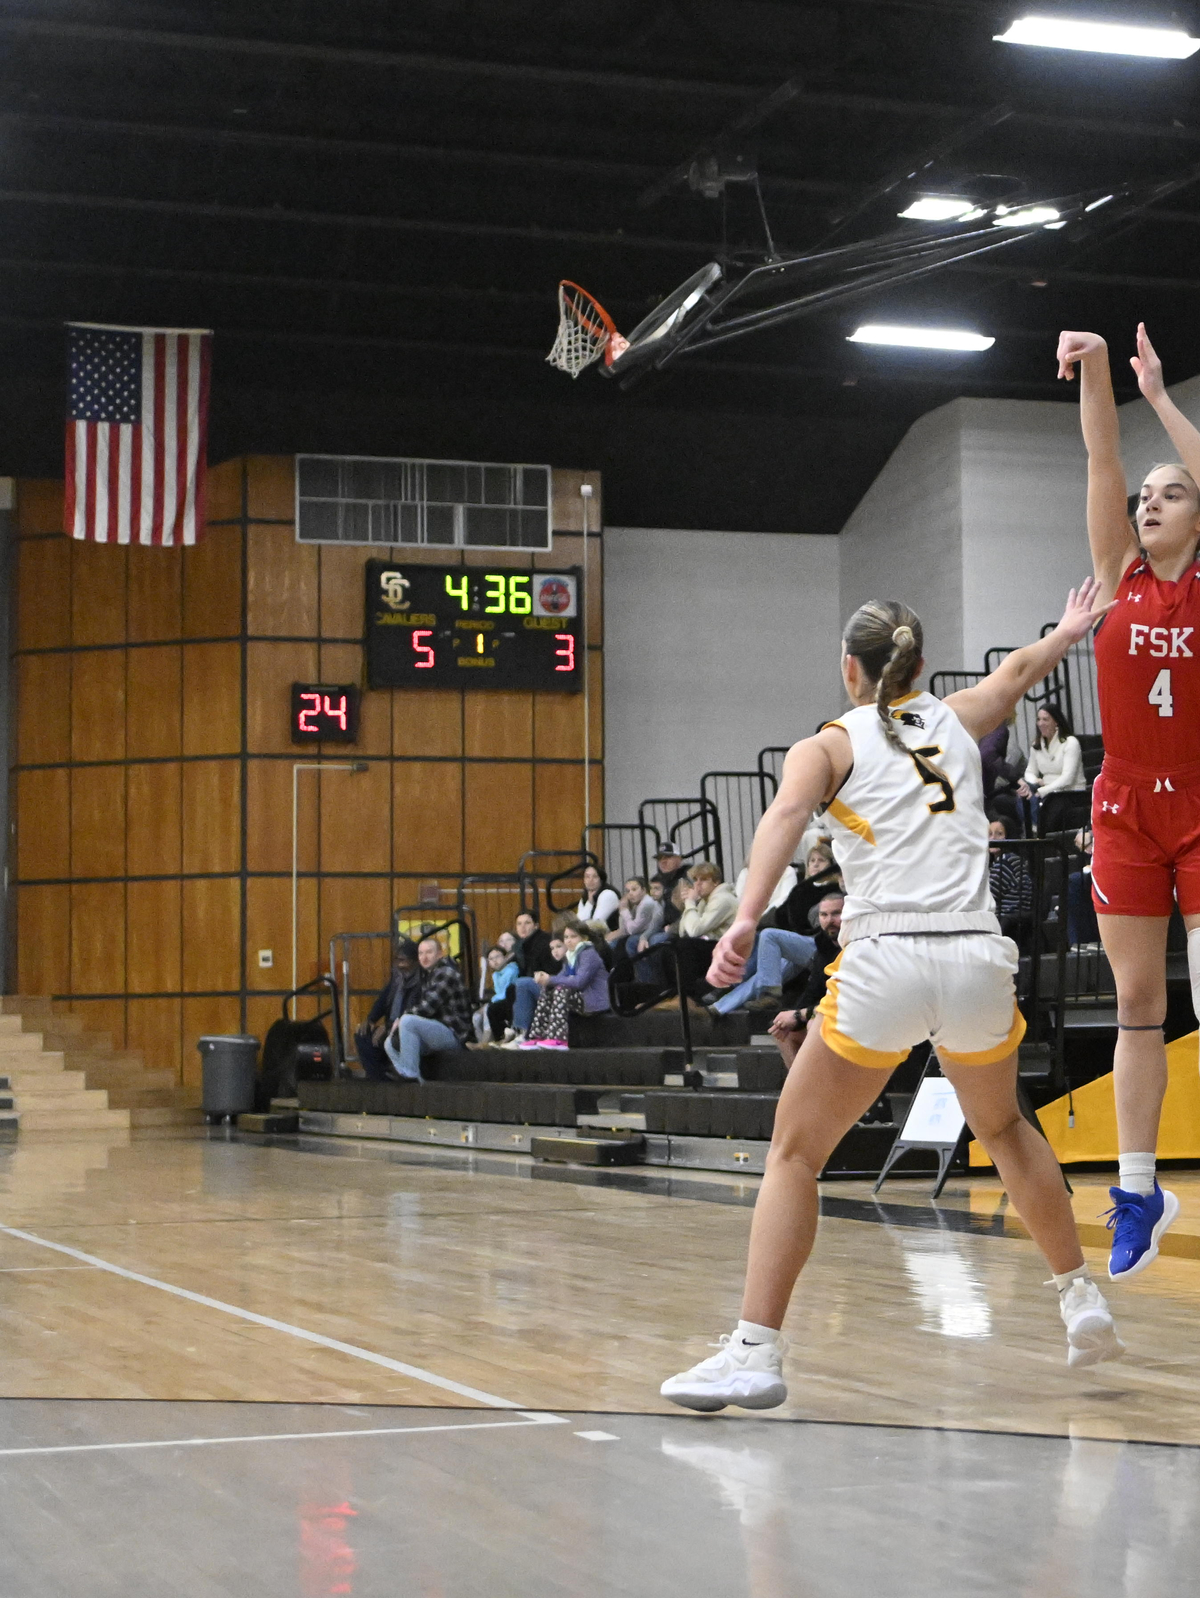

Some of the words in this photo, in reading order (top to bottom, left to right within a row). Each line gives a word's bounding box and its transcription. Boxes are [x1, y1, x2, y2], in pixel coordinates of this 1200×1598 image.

[445, 574, 531, 614] 4:36
[523, 616, 568, 630] GUEST
[1128, 623, 1194, 658] FSK
[411, 630, 435, 669] 5
[476, 633, 485, 654] 1
[554, 634, 575, 672] 3
[1148, 668, 1174, 717] 4
[299, 693, 347, 732] 24
[909, 744, 956, 815] 5
